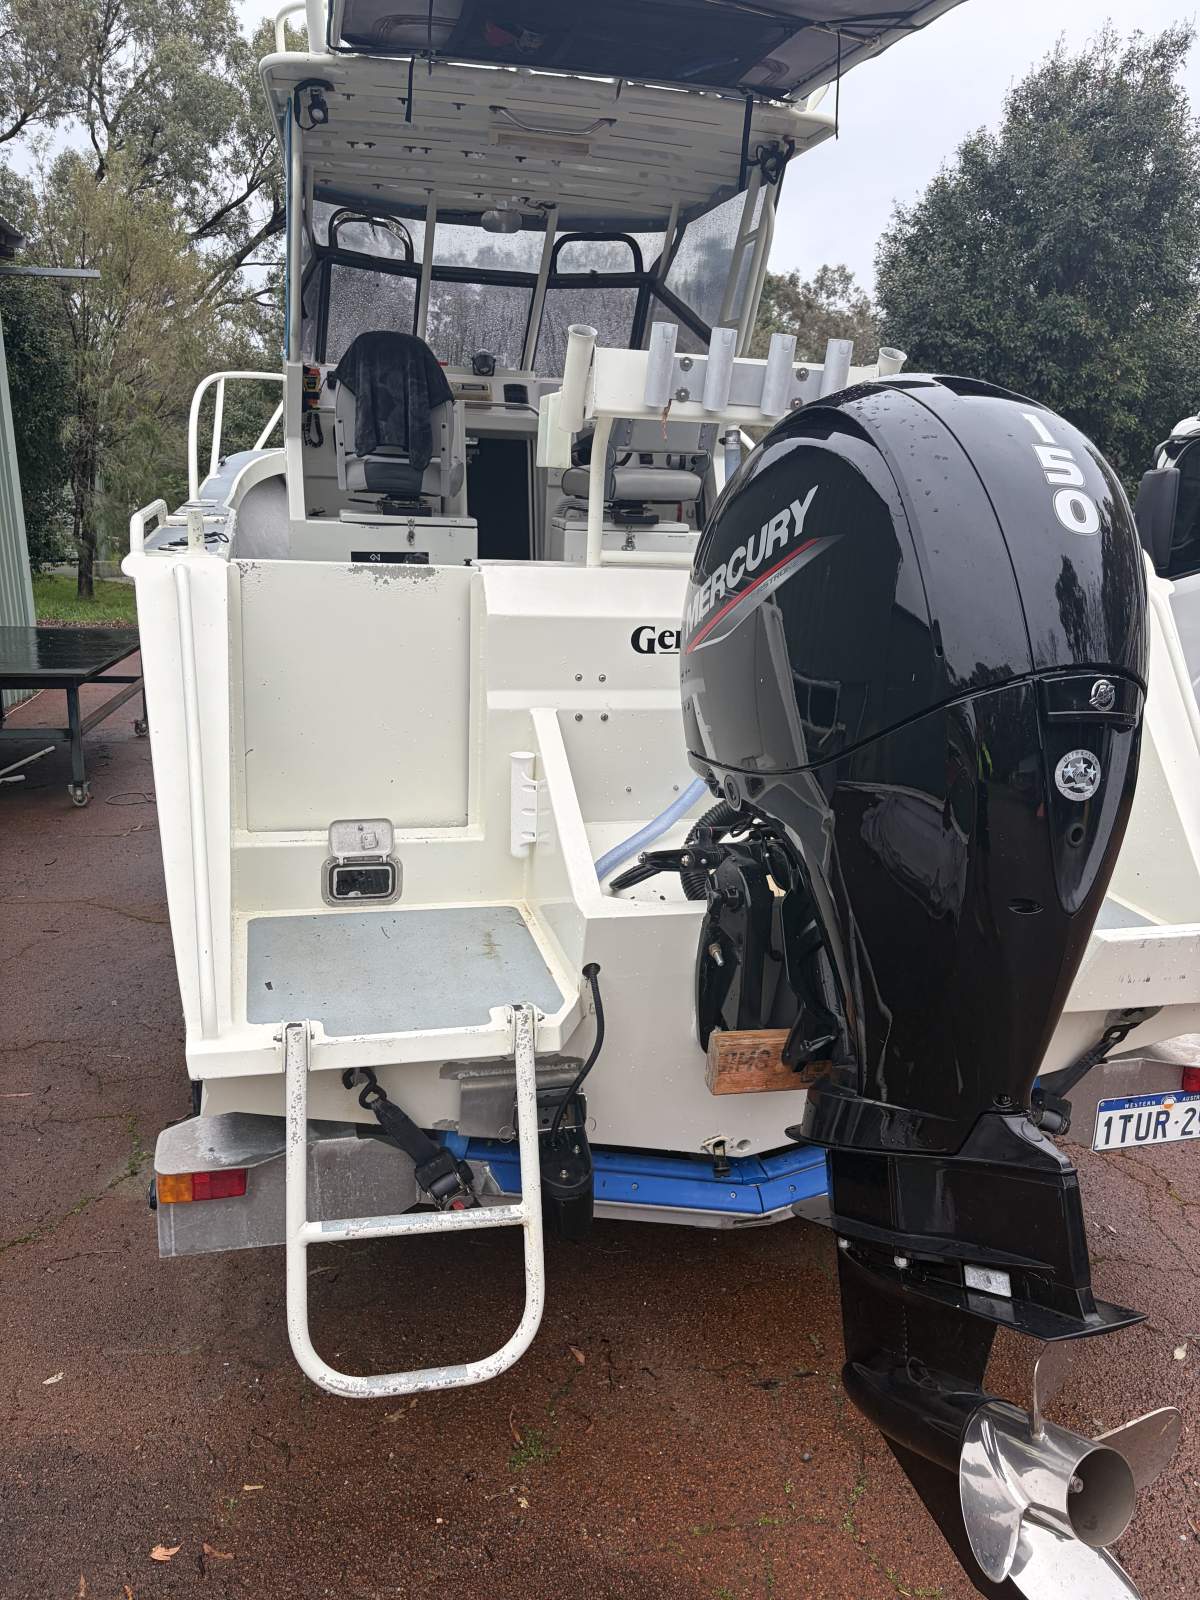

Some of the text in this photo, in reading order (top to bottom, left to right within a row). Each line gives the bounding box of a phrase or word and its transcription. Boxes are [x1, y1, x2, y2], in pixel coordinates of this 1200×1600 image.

[1021, 412, 1101, 536] 150
[685, 485, 819, 640] MERCURY
[1124, 1100, 1156, 1109] WESTERN
